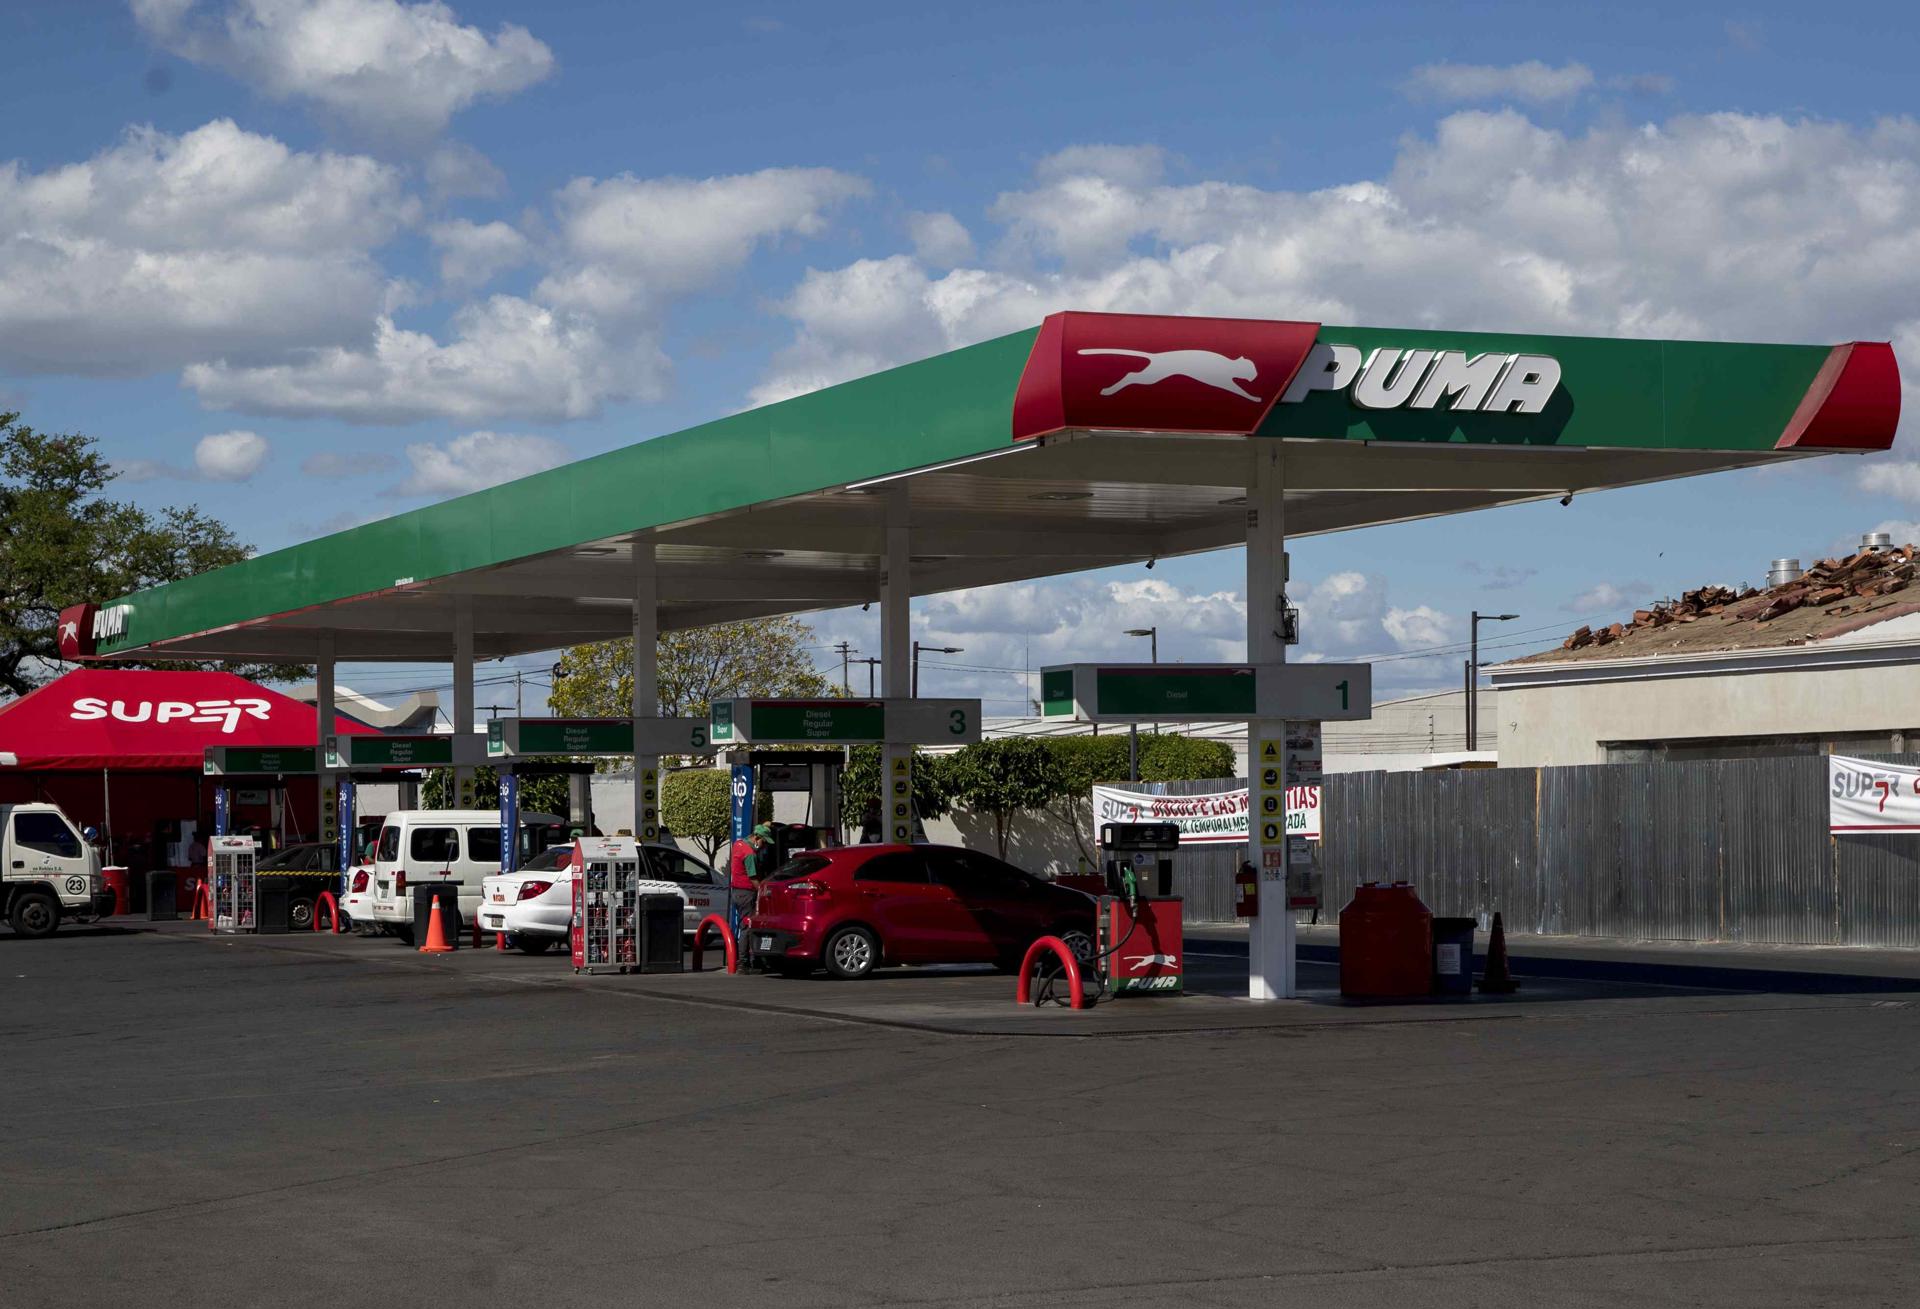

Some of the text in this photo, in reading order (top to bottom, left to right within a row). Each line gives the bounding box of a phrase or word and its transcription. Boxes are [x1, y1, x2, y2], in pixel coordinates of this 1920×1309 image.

[1280, 344, 1561, 413] PUMA
[91, 604, 128, 640] PUMA
[1166, 690, 1188, 699] Diesel
[1336, 680, 1348, 710] 1
[806, 711, 831, 719] Diesel
[803, 720, 833, 729] Regular
[949, 710, 966, 735] 3
[565, 727, 588, 735] Diesel
[691, 727, 705, 747] 5
[806, 729, 831, 738] Super
[563, 735, 590, 744] Regular
[566, 743, 588, 752] Super
[1151, 799, 1209, 816] DISCULPE
[1212, 796, 1236, 812] LAS
[69, 879, 83, 891] 23
[1126, 976, 1177, 990] PUMA
